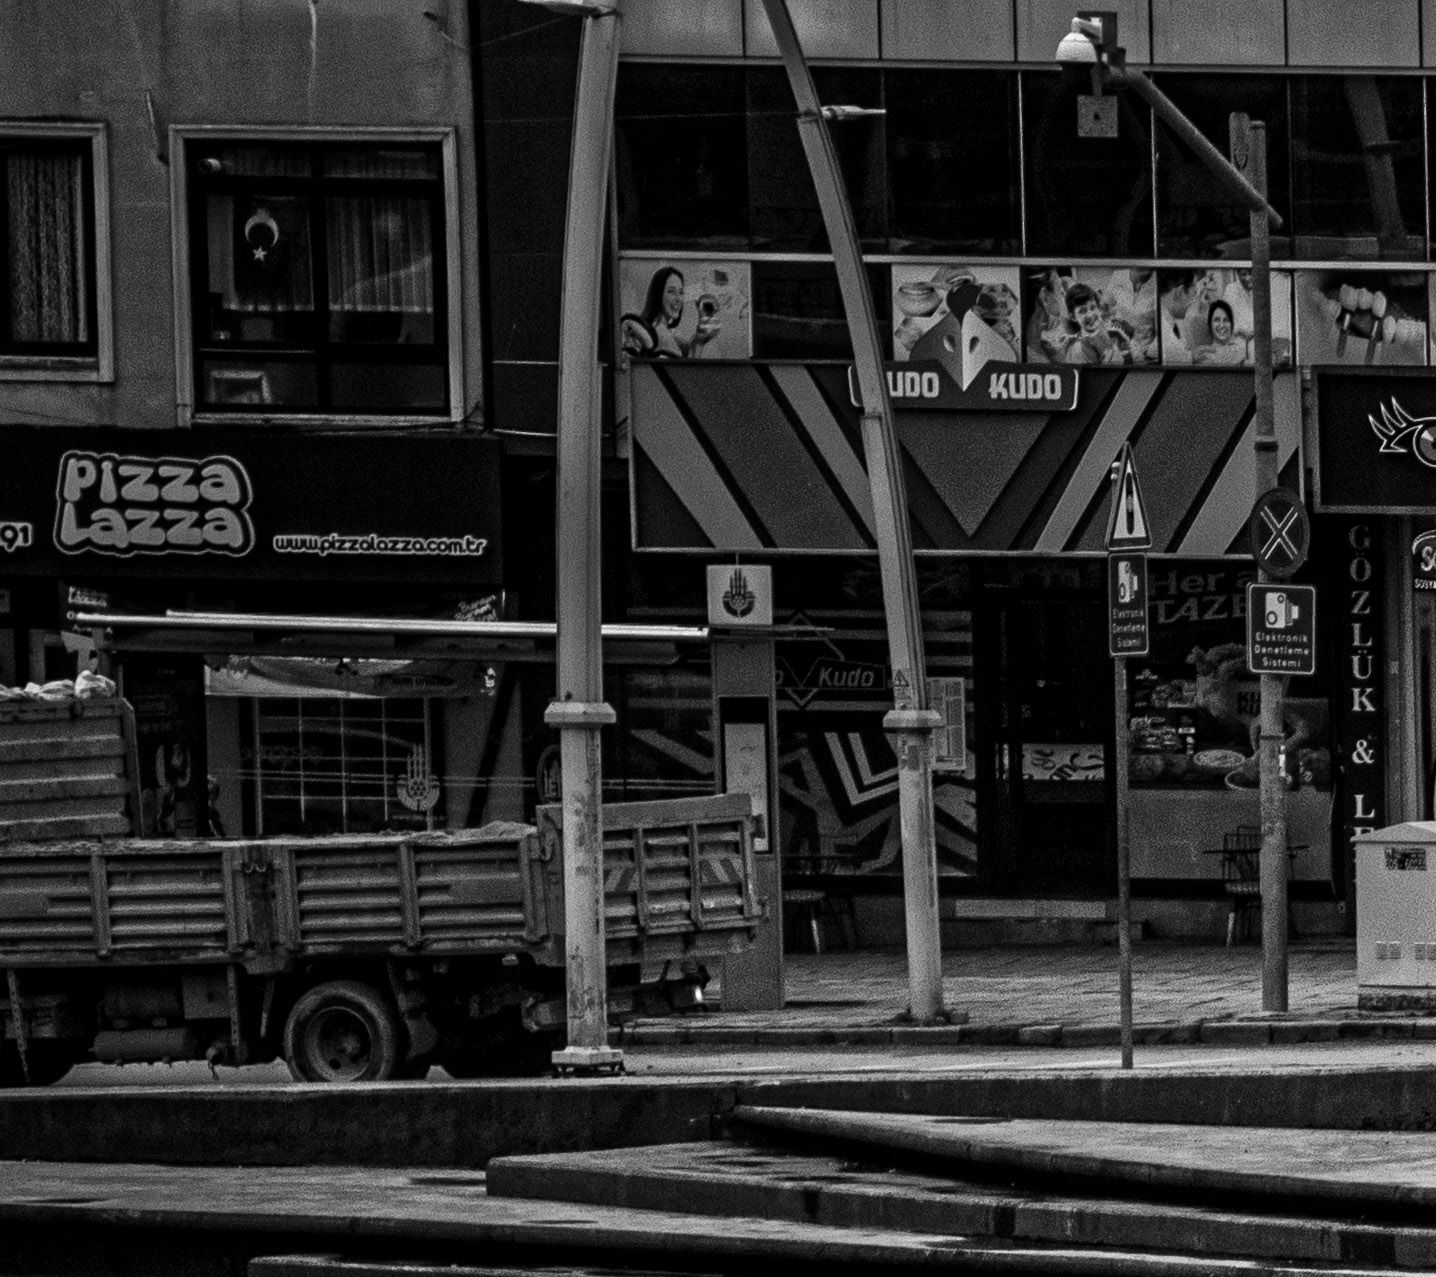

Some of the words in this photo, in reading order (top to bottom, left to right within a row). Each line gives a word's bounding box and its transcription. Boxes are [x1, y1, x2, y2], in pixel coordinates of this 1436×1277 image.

[887, 371, 940, 399] UDO
[988, 372, 1062, 400] KUDO
[1348, 523, 1377, 712] GÖZLÜK
[1254, 631, 1308, 643] Elektronik
[1253, 644, 1310, 656] Denetleme
[1262, 656, 1302, 668] Sistemi
[818, 666, 875, 688] Kudo
[1350, 738, 1376, 765] &
